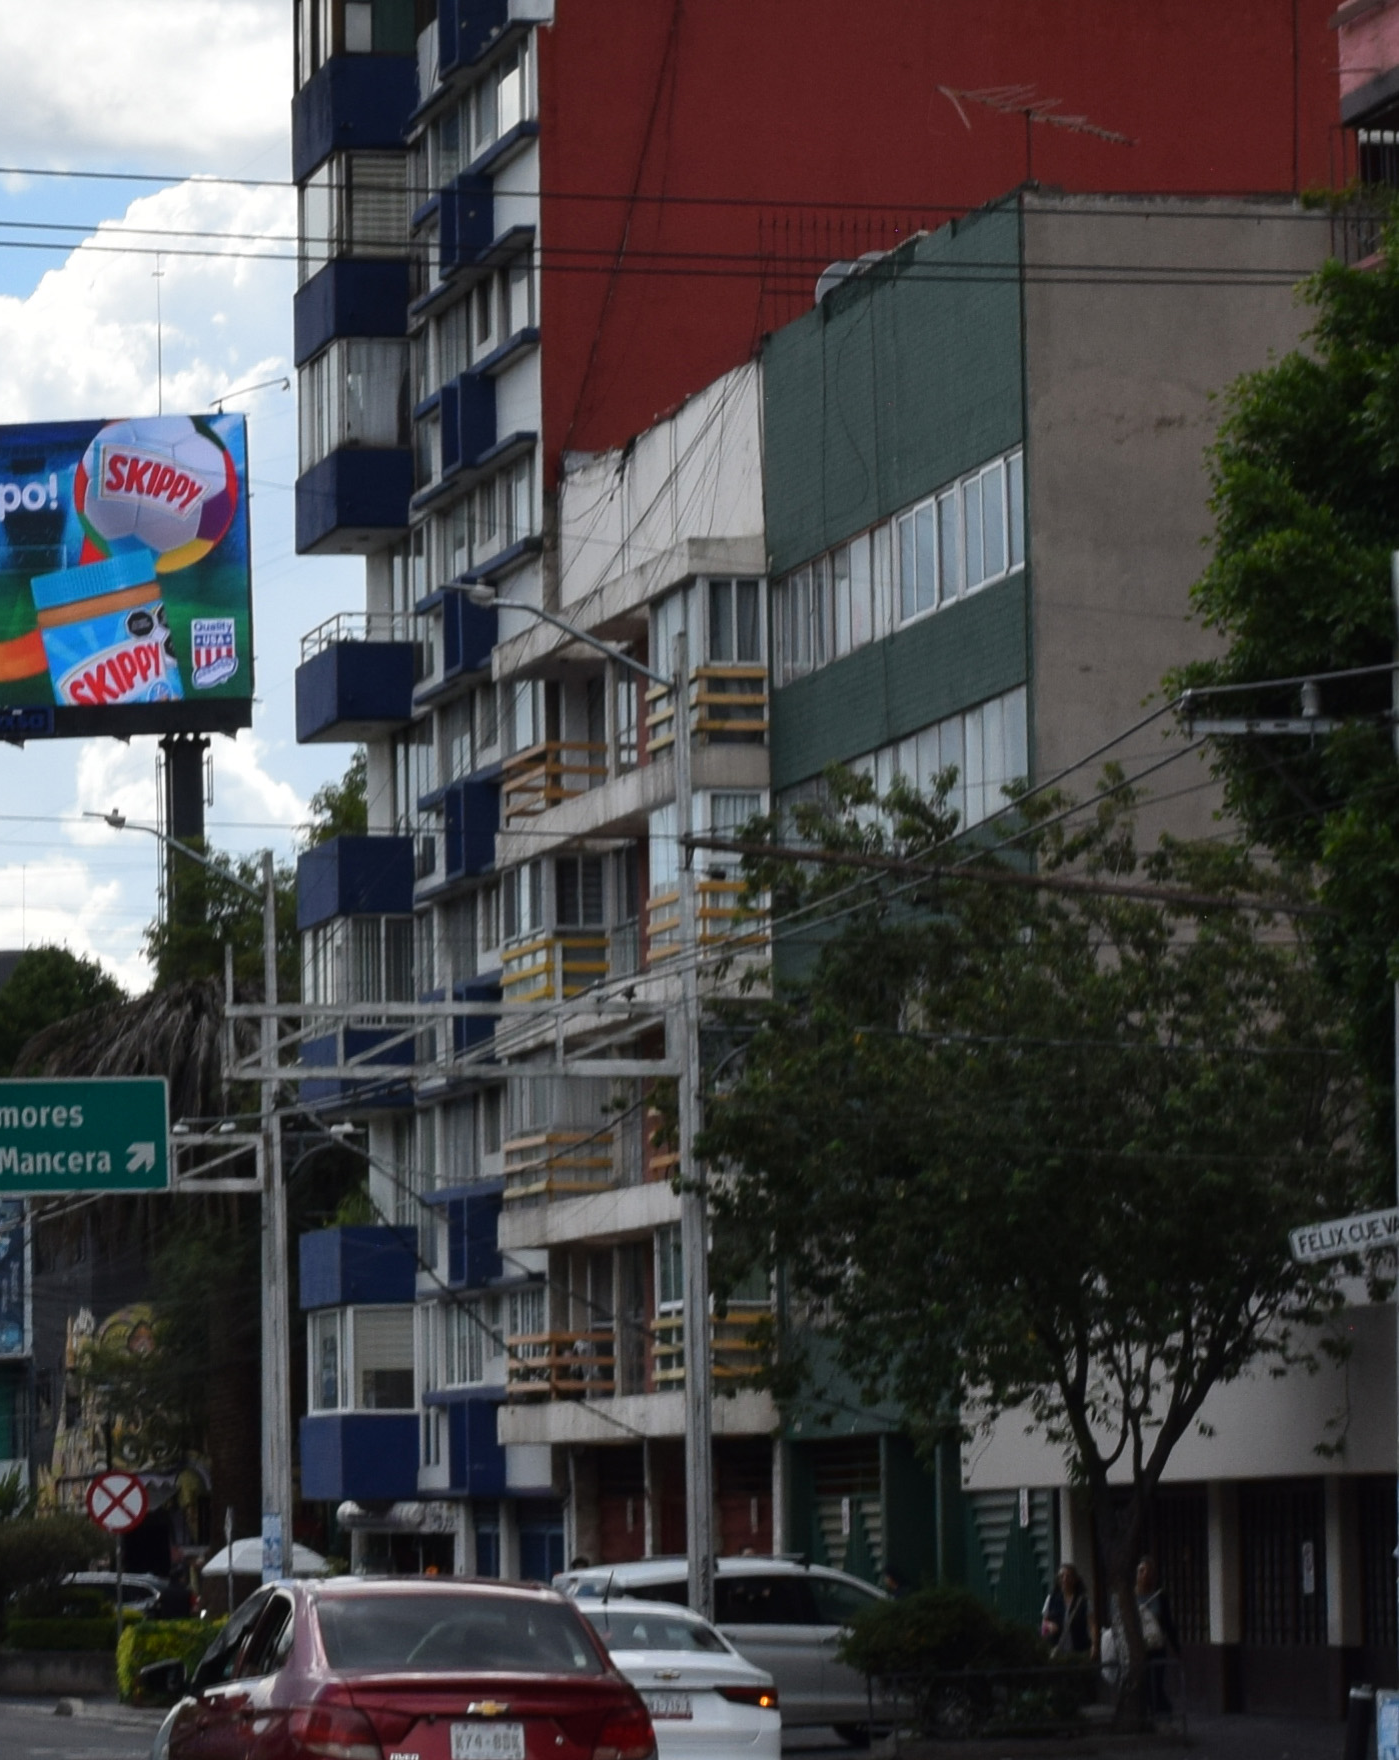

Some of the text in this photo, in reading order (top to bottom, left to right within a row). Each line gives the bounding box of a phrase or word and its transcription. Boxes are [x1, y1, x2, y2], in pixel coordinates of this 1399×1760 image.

[105, 454, 203, 510] SKIPPY
[194, 620, 233, 635] Quality
[202, 634, 225, 646] USA
[69, 641, 161, 706] SKIPPY
[1298, 1226, 1348, 1254] FELIX
